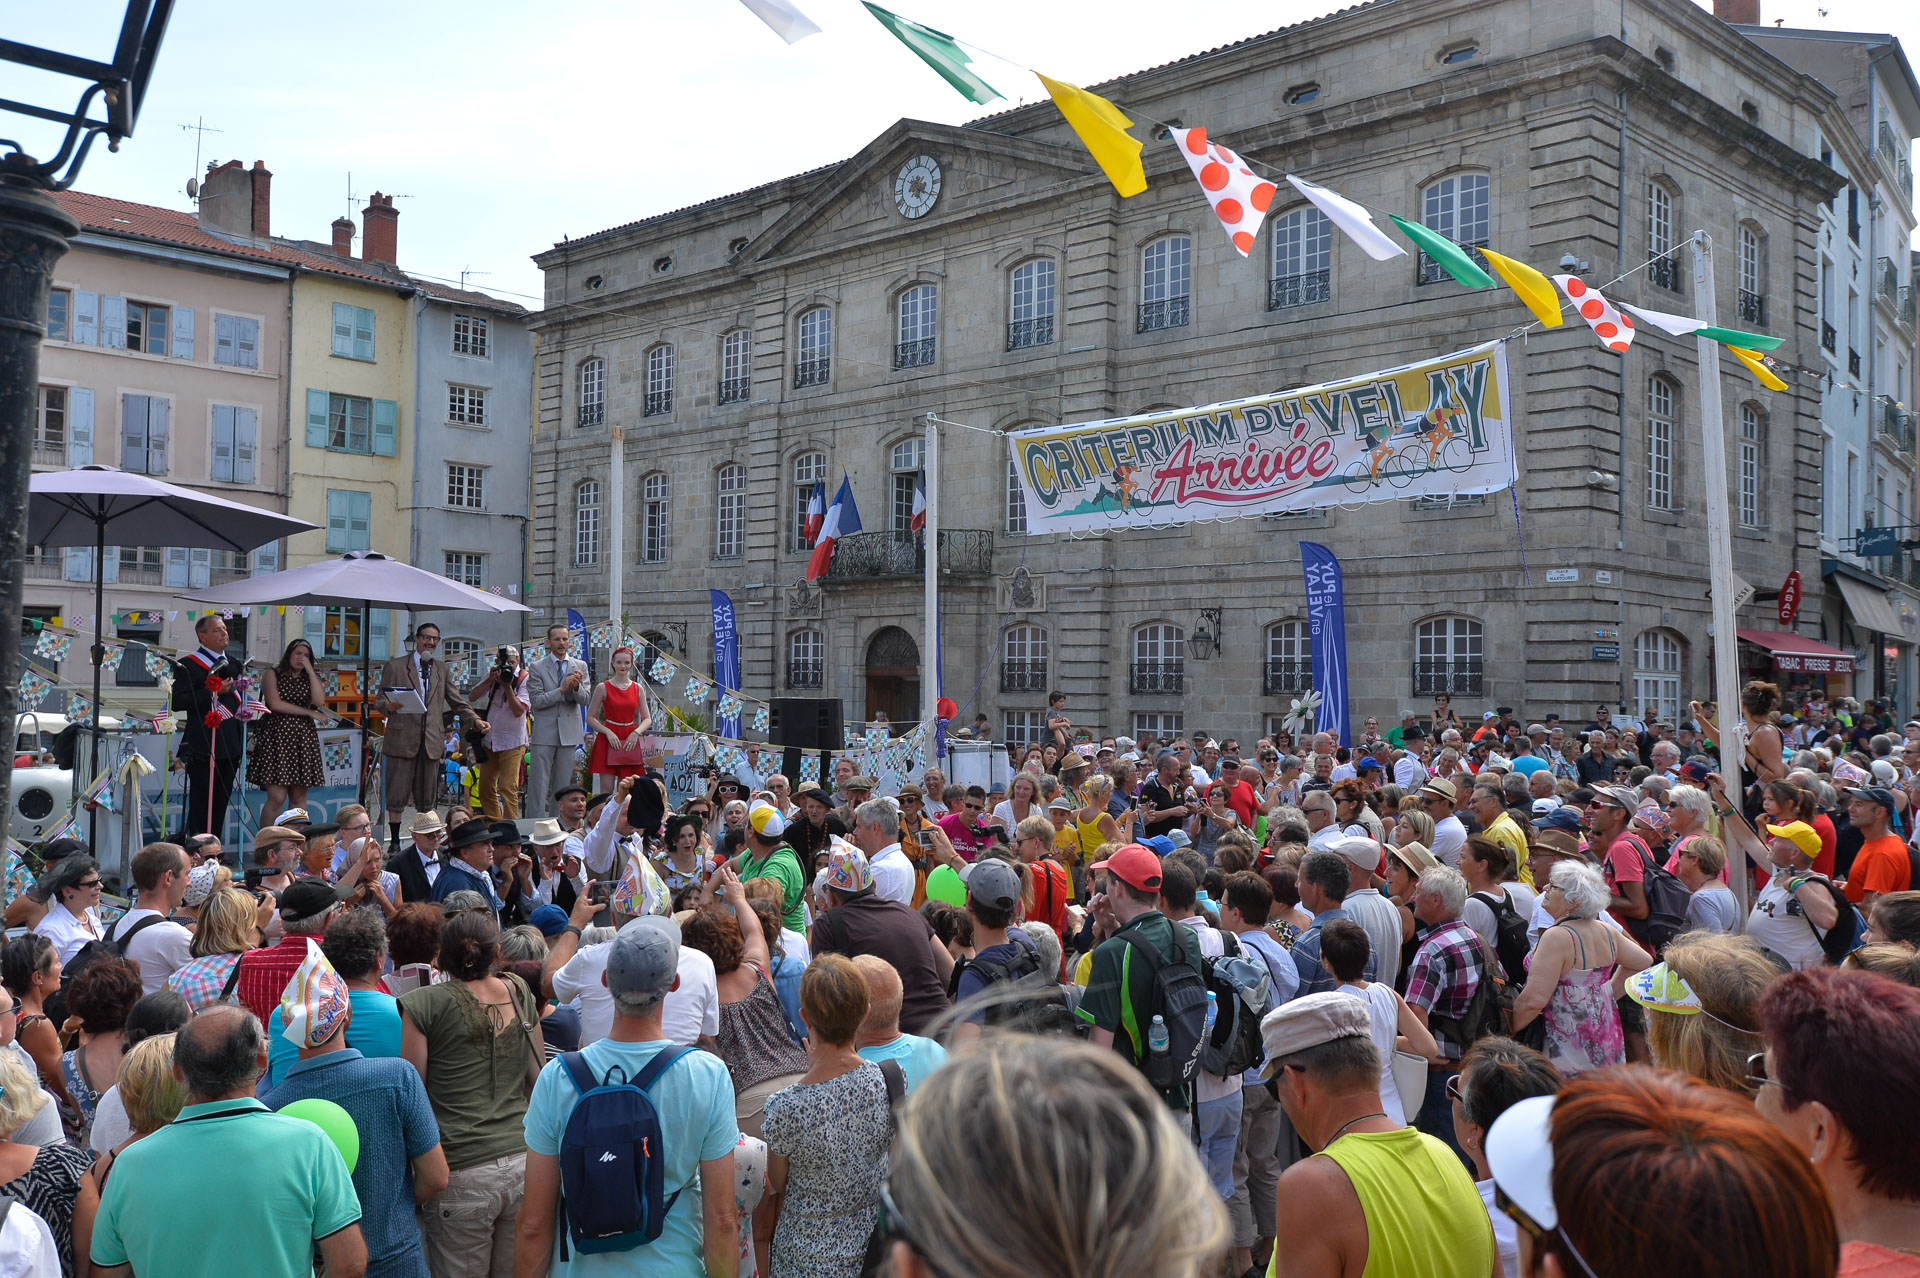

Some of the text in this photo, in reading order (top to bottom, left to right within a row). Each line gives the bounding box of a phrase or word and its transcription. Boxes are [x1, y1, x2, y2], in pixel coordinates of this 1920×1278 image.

[1025, 409, 1240, 509] CRITERIUM
[1240, 397, 1304, 434] DU
[1304, 357, 1492, 454] VELAY
[1153, 420, 1338, 507] Arrivée
[1780, 577, 1797, 619] TABAC
[1777, 657, 1852, 673] TABAC PRESSE JEUX
[330, 774, 352, 787] faut
[670, 774, 693, 792] 402
[33, 824, 43, 837] 2
